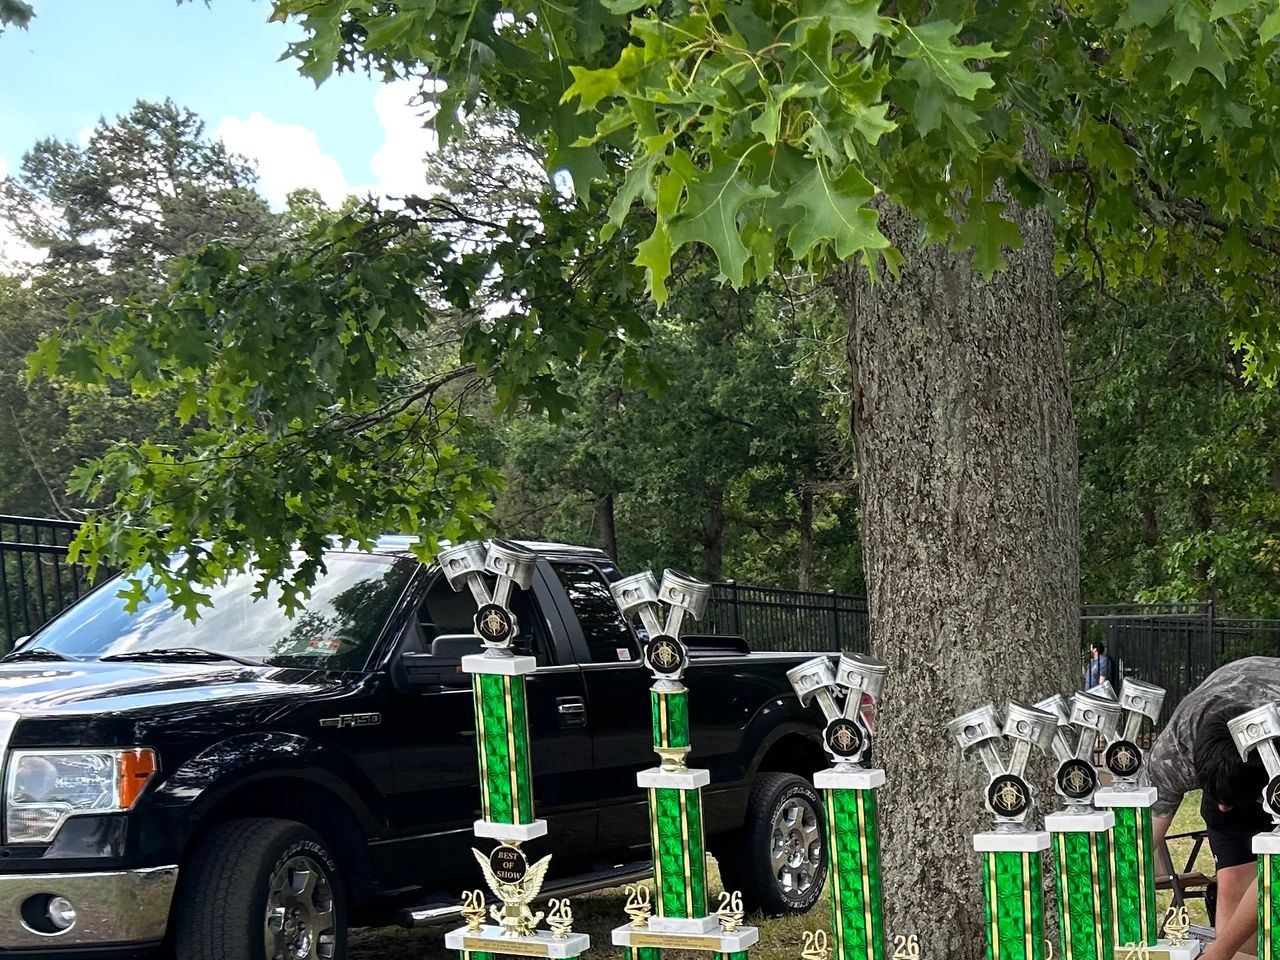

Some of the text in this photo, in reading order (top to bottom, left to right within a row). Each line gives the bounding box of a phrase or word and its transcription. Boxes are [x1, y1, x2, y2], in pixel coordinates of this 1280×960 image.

[498, 852, 519, 861] BEST
[503, 861, 514, 869] OF
[496, 871, 521, 880] SHOW
[461, 890, 572, 918] 20 26
[625, 885, 744, 913] 20 26
[1165, 906, 1190, 927] 26
[802, 929, 920, 956] 20 26
